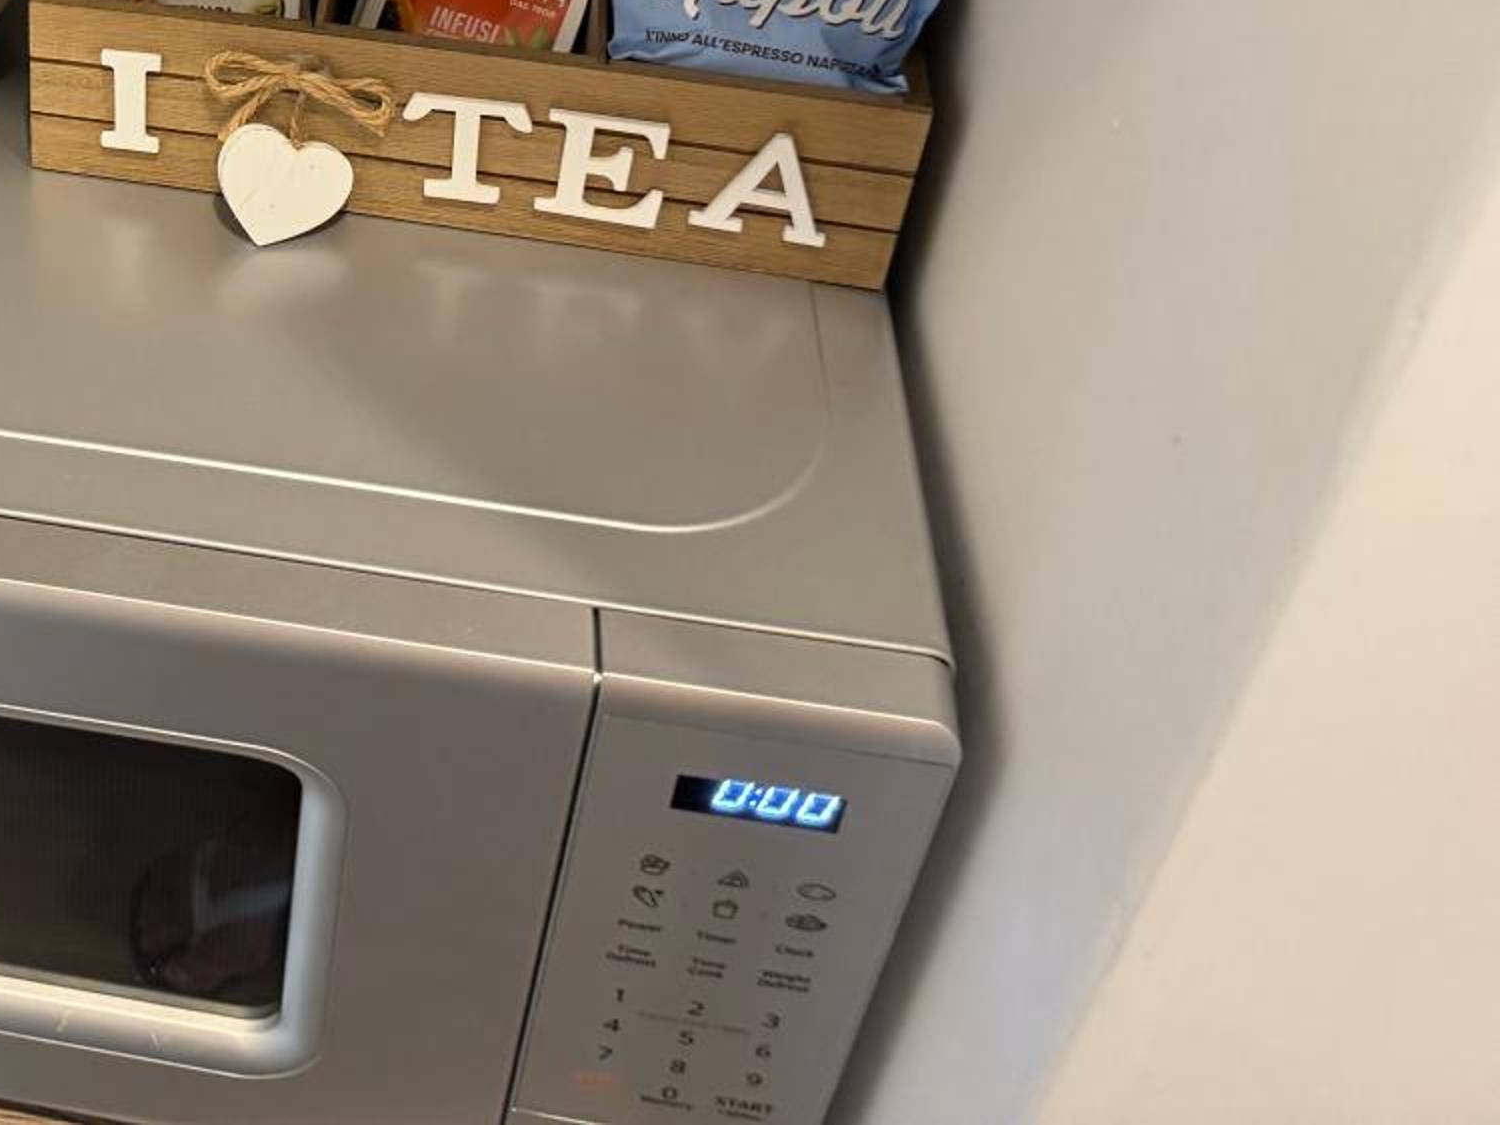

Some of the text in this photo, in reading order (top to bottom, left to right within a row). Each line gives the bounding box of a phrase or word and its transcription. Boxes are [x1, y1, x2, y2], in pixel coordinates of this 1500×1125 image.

[429, 5, 500, 44] INFUSI
[691, 33, 803, 65] ALL'ESPRESSO
[99, 48, 827, 249] I TEA
[710, 778, 842, 825] 0:00
[615, 988, 626, 1003] 1
[687, 1000, 705, 1017] 2
[603, 1018, 620, 1032] 4
[764, 1013, 780, 1029] 3
[678, 1031, 695, 1046] 5
[598, 1045, 613, 1060] 7
